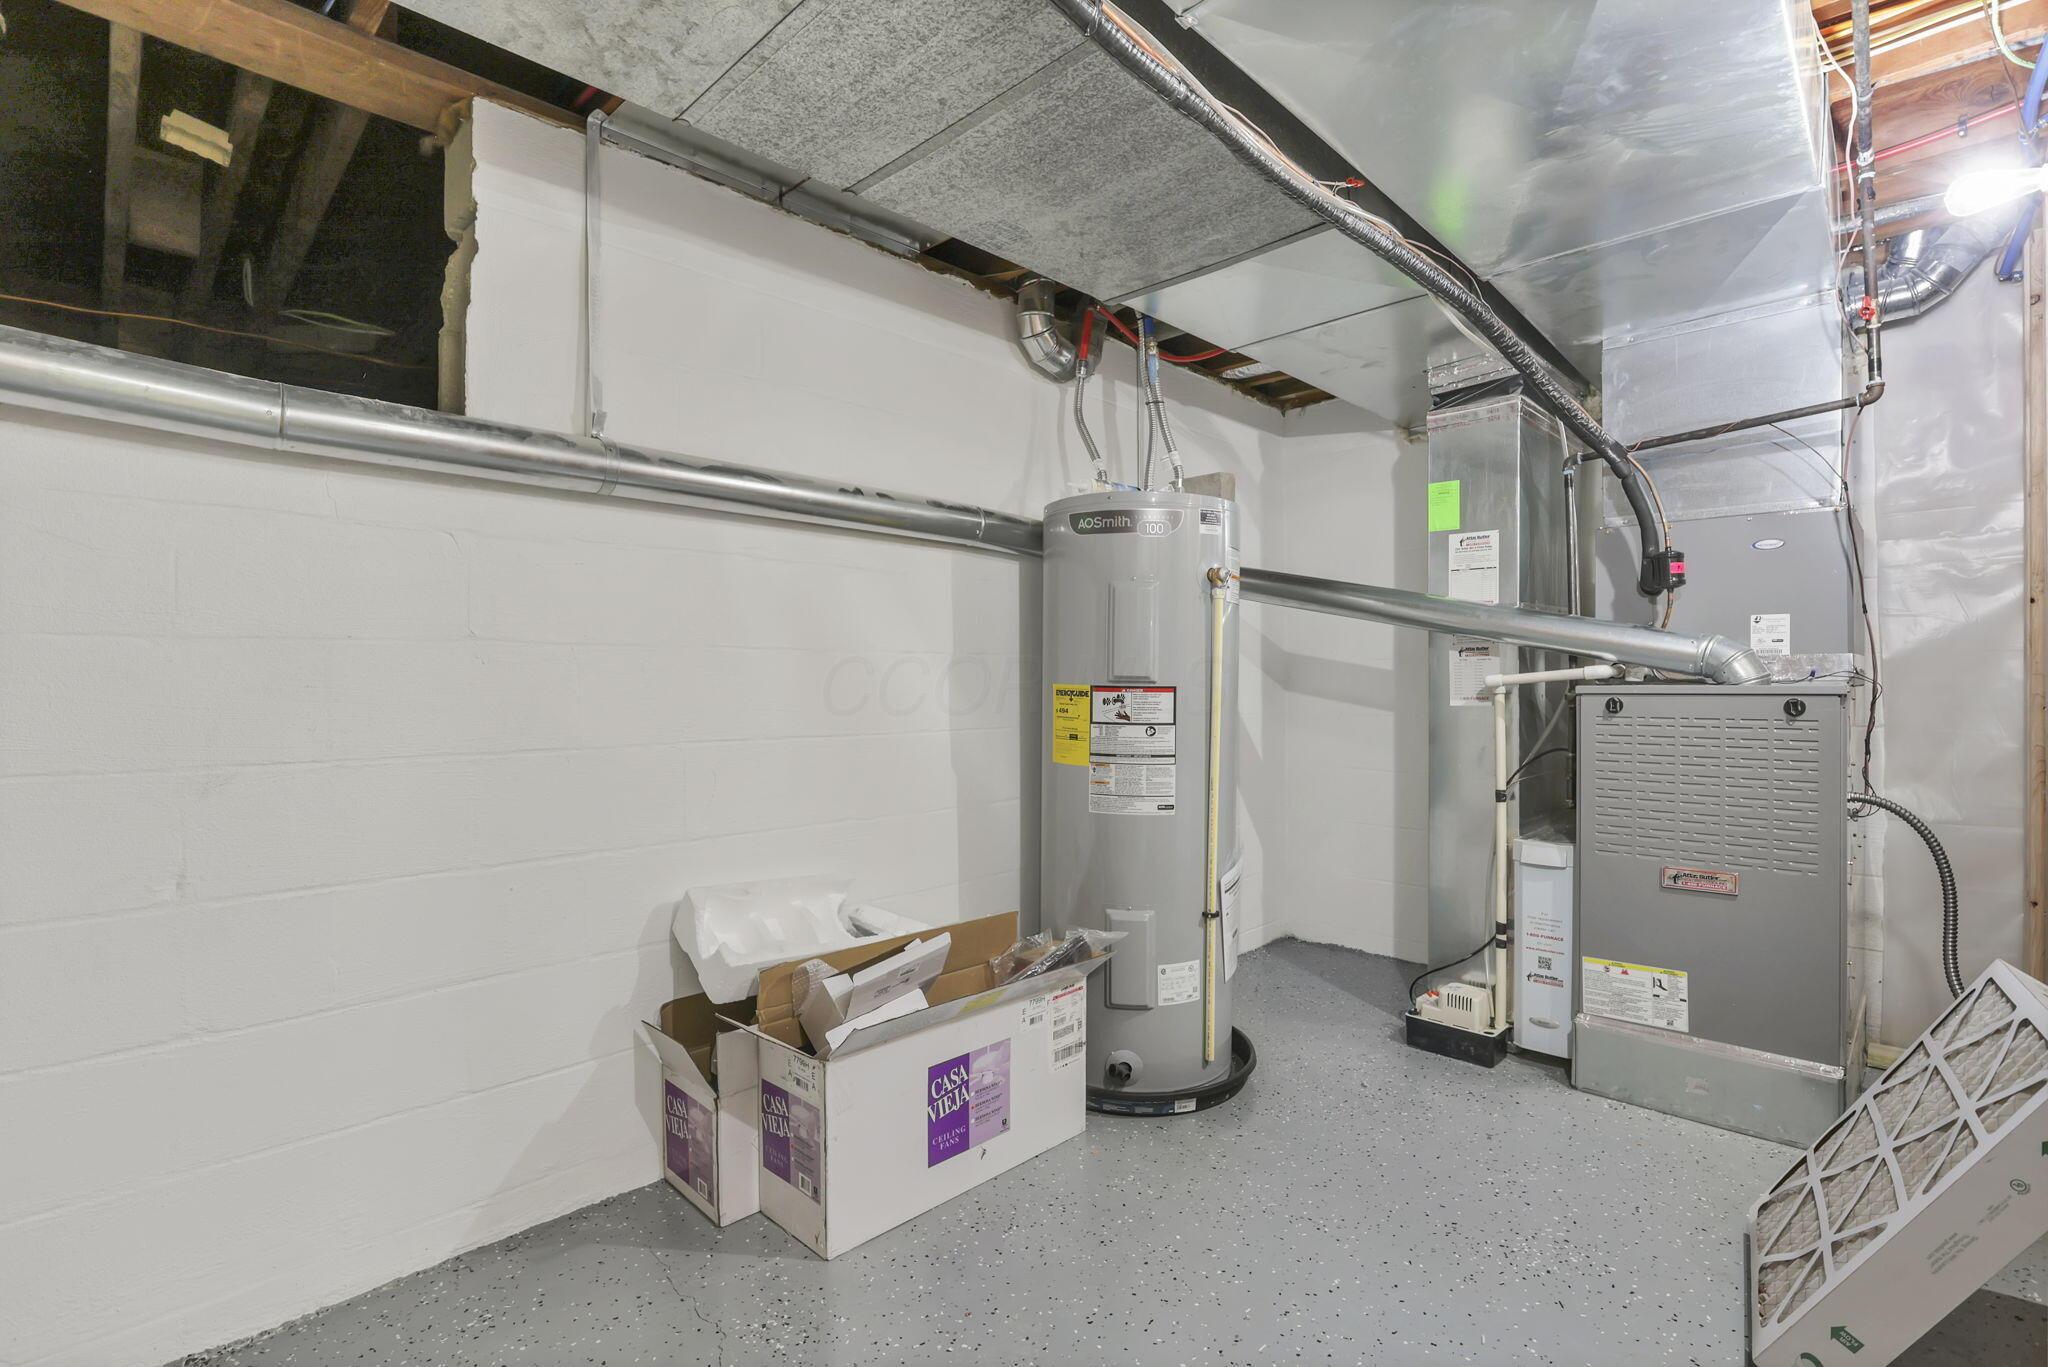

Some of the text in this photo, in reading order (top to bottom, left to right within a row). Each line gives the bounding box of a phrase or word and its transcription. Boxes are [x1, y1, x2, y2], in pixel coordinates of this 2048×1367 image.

[1145, 523, 1164, 534] 100
[931, 1064, 969, 1099] CASA
[667, 1095, 688, 1118] CASA
[762, 1093, 789, 1117] CASA
[927, 1084, 970, 1123] VIEJA
[932, 1125, 966, 1146] CEILING
[940, 1137, 960, 1150] FANS
